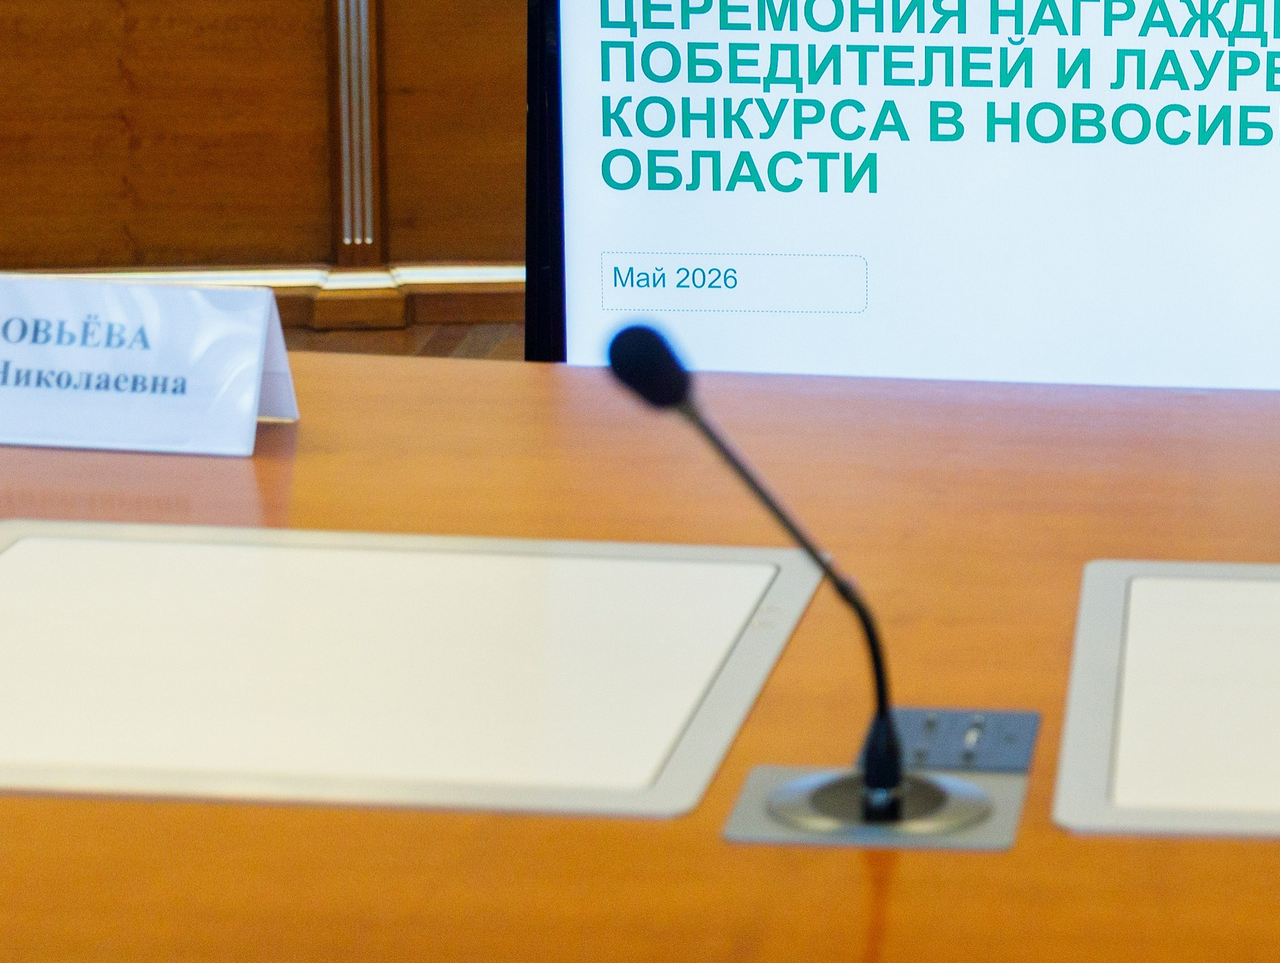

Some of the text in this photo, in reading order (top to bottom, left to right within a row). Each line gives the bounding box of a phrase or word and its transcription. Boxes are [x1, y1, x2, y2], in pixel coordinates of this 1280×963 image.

[601, 37, 1033, 94] ПОБЕДИТЕЛЕЙ
[1057, 48, 1091, 90] И
[601, 96, 910, 142] КОНКУРСА
[929, 101, 965, 142] В
[601, 149, 878, 194] ОБЛАСТИ
[613, 266, 738, 290] Май 2026
